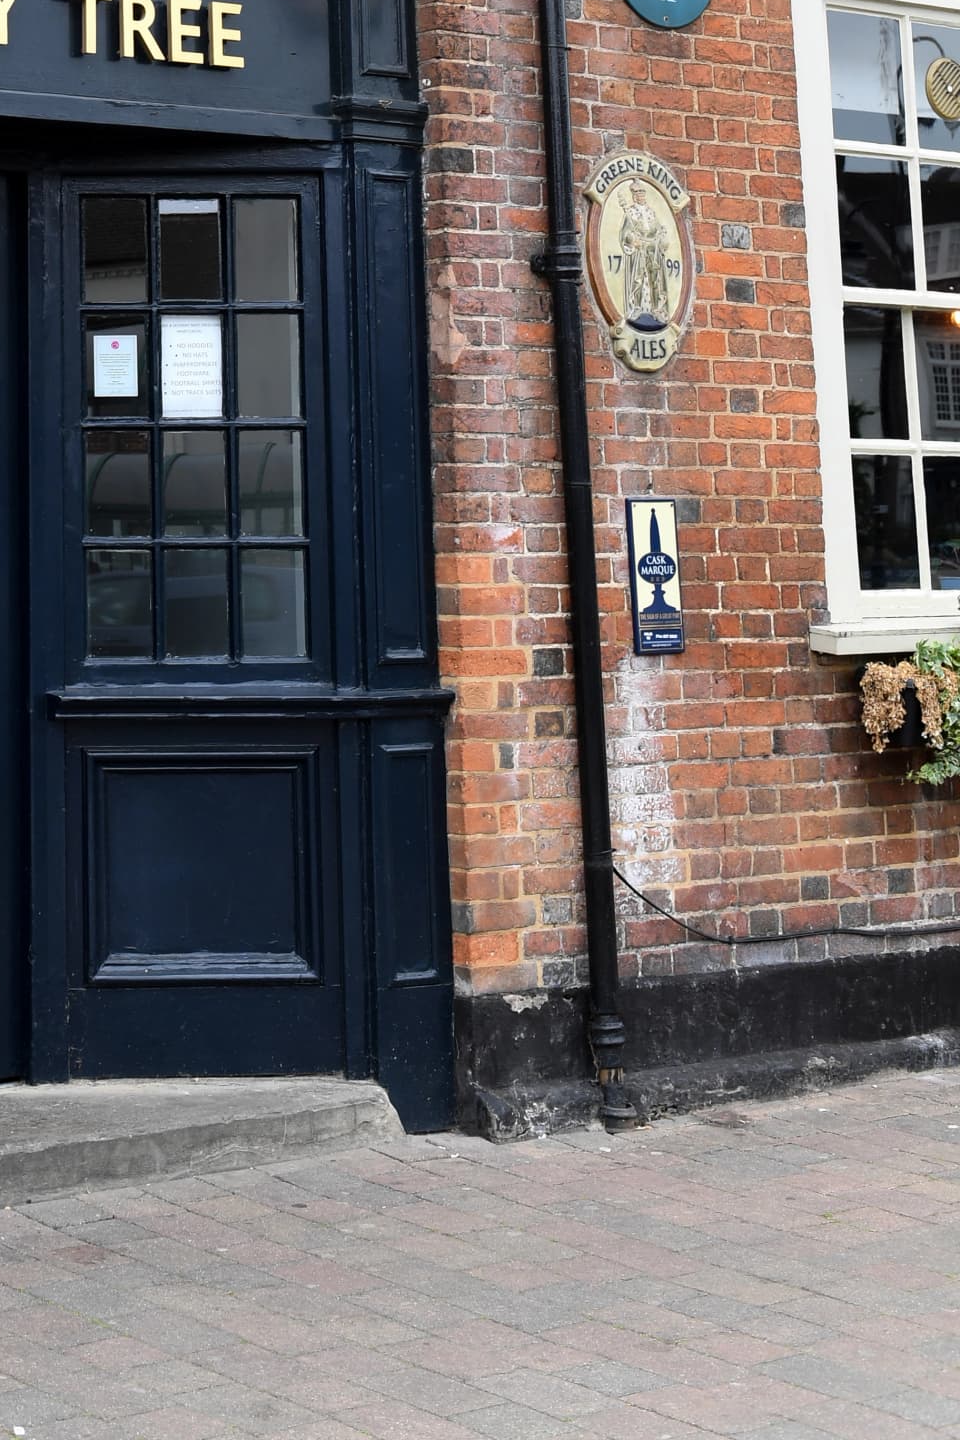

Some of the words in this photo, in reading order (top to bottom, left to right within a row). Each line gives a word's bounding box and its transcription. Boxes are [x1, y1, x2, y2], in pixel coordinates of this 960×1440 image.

[595, 157, 644, 194] GREENE
[647, 161, 682, 200] KING
[608, 255, 622, 274] 17
[666, 259, 680, 278] 99
[630, 338, 667, 361] ALES
[641, 565, 674, 576] MARQUE
[646, 555, 666, 565] CASK
